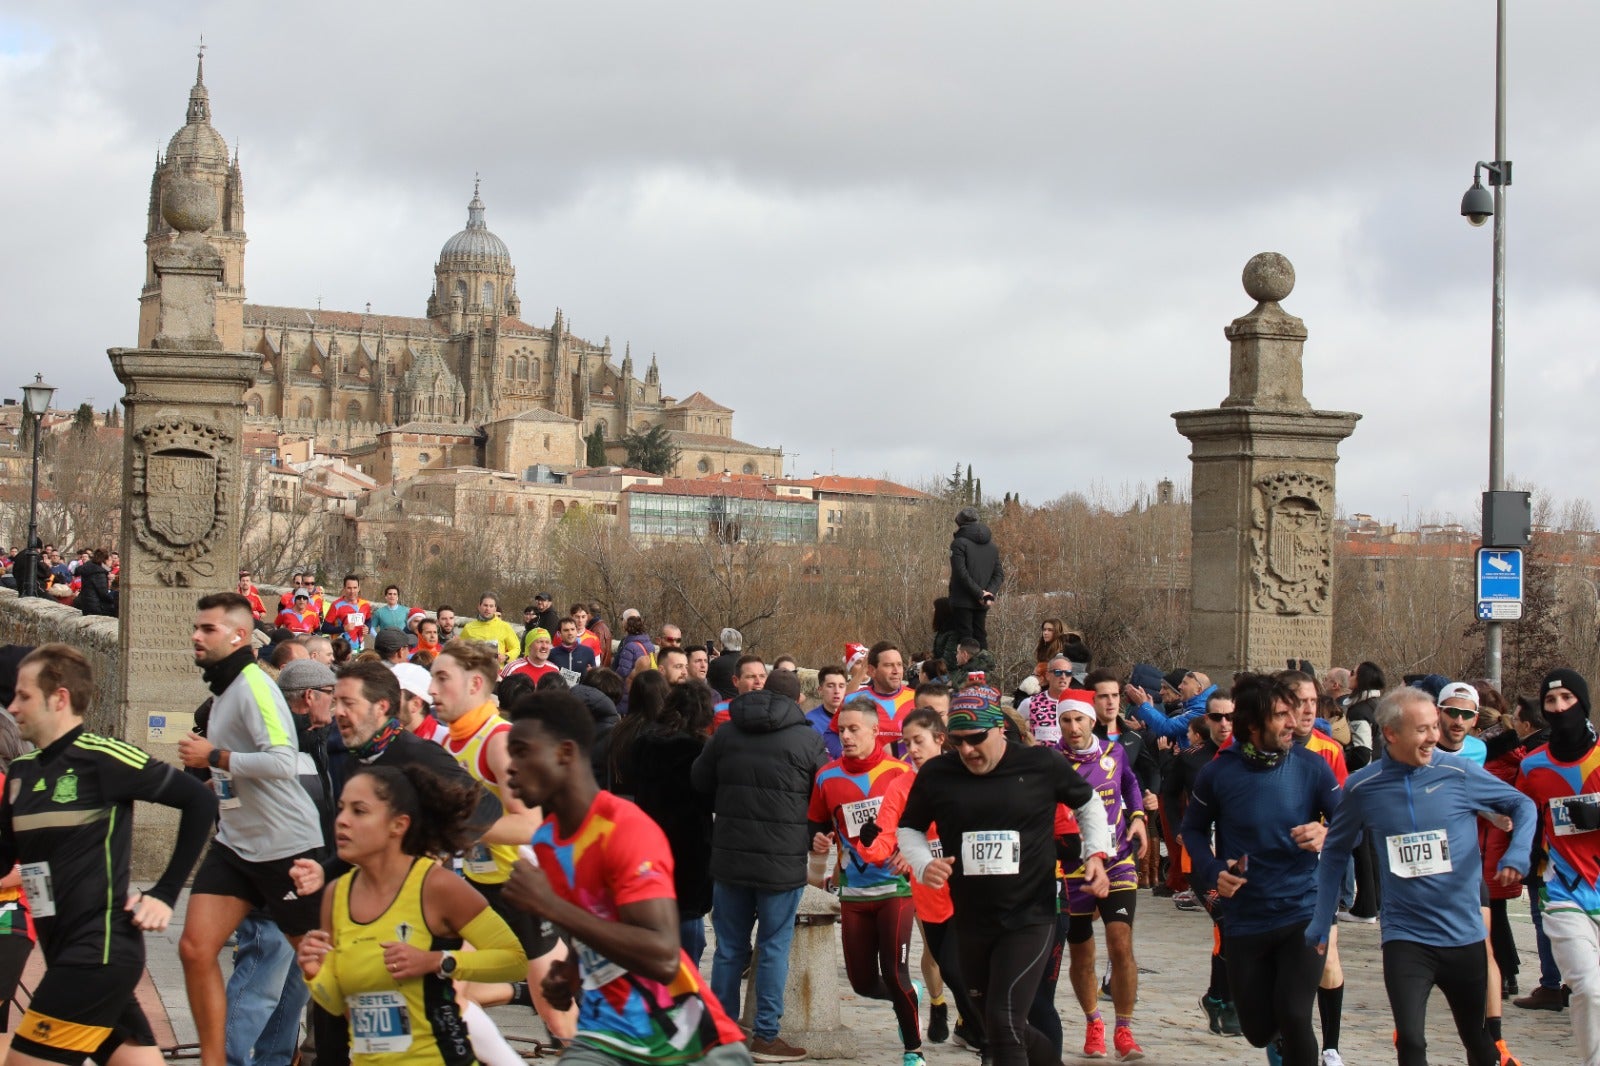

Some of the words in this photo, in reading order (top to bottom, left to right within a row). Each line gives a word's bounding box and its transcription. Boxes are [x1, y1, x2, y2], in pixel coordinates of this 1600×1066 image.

[855, 800, 881, 810] SETEL
[852, 808, 878, 824] 1393
[977, 833, 1013, 841] SETEL
[1402, 834, 1441, 844] SETEL
[971, 843, 1002, 860] 1872
[1399, 843, 1432, 864] 1079
[360, 995, 399, 1006] SETEL
